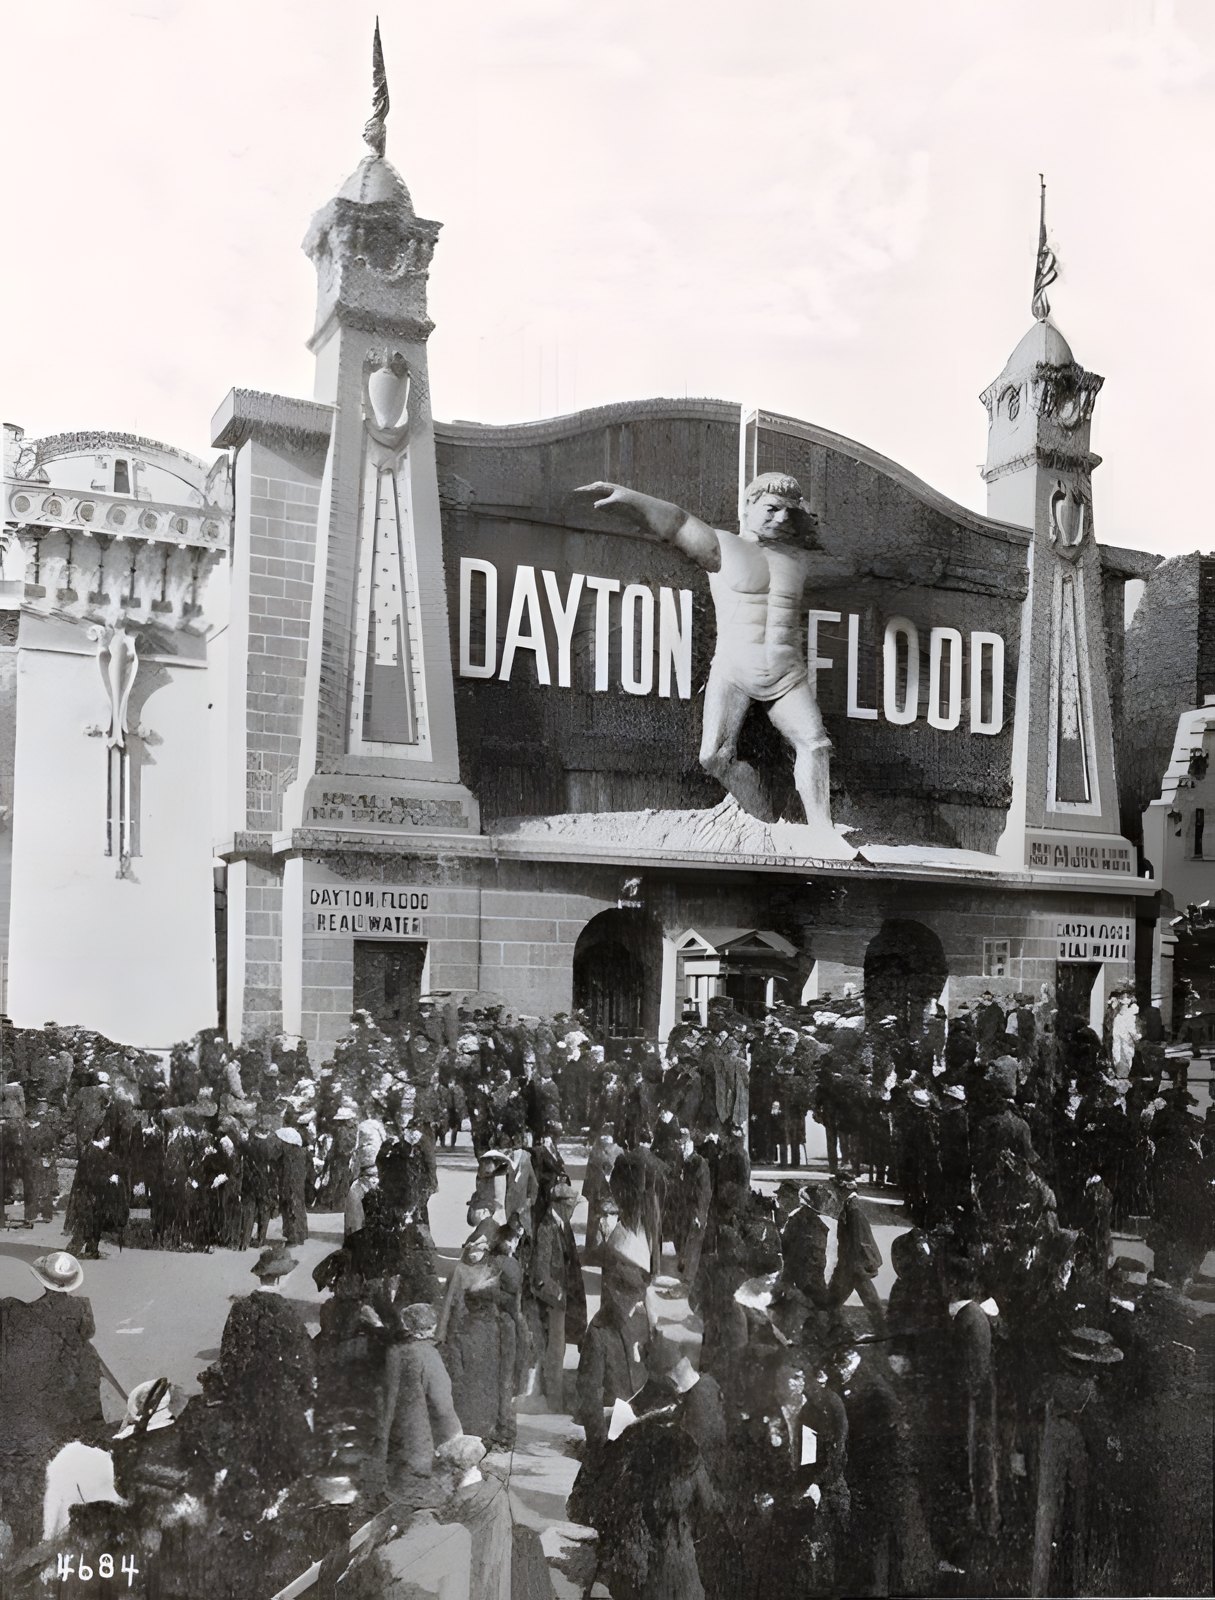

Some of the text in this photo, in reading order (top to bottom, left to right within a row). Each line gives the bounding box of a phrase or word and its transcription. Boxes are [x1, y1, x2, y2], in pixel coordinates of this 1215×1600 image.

[459, 556, 1005, 735] DAYTON FLOOD
[310, 889, 374, 908] DAYTON
